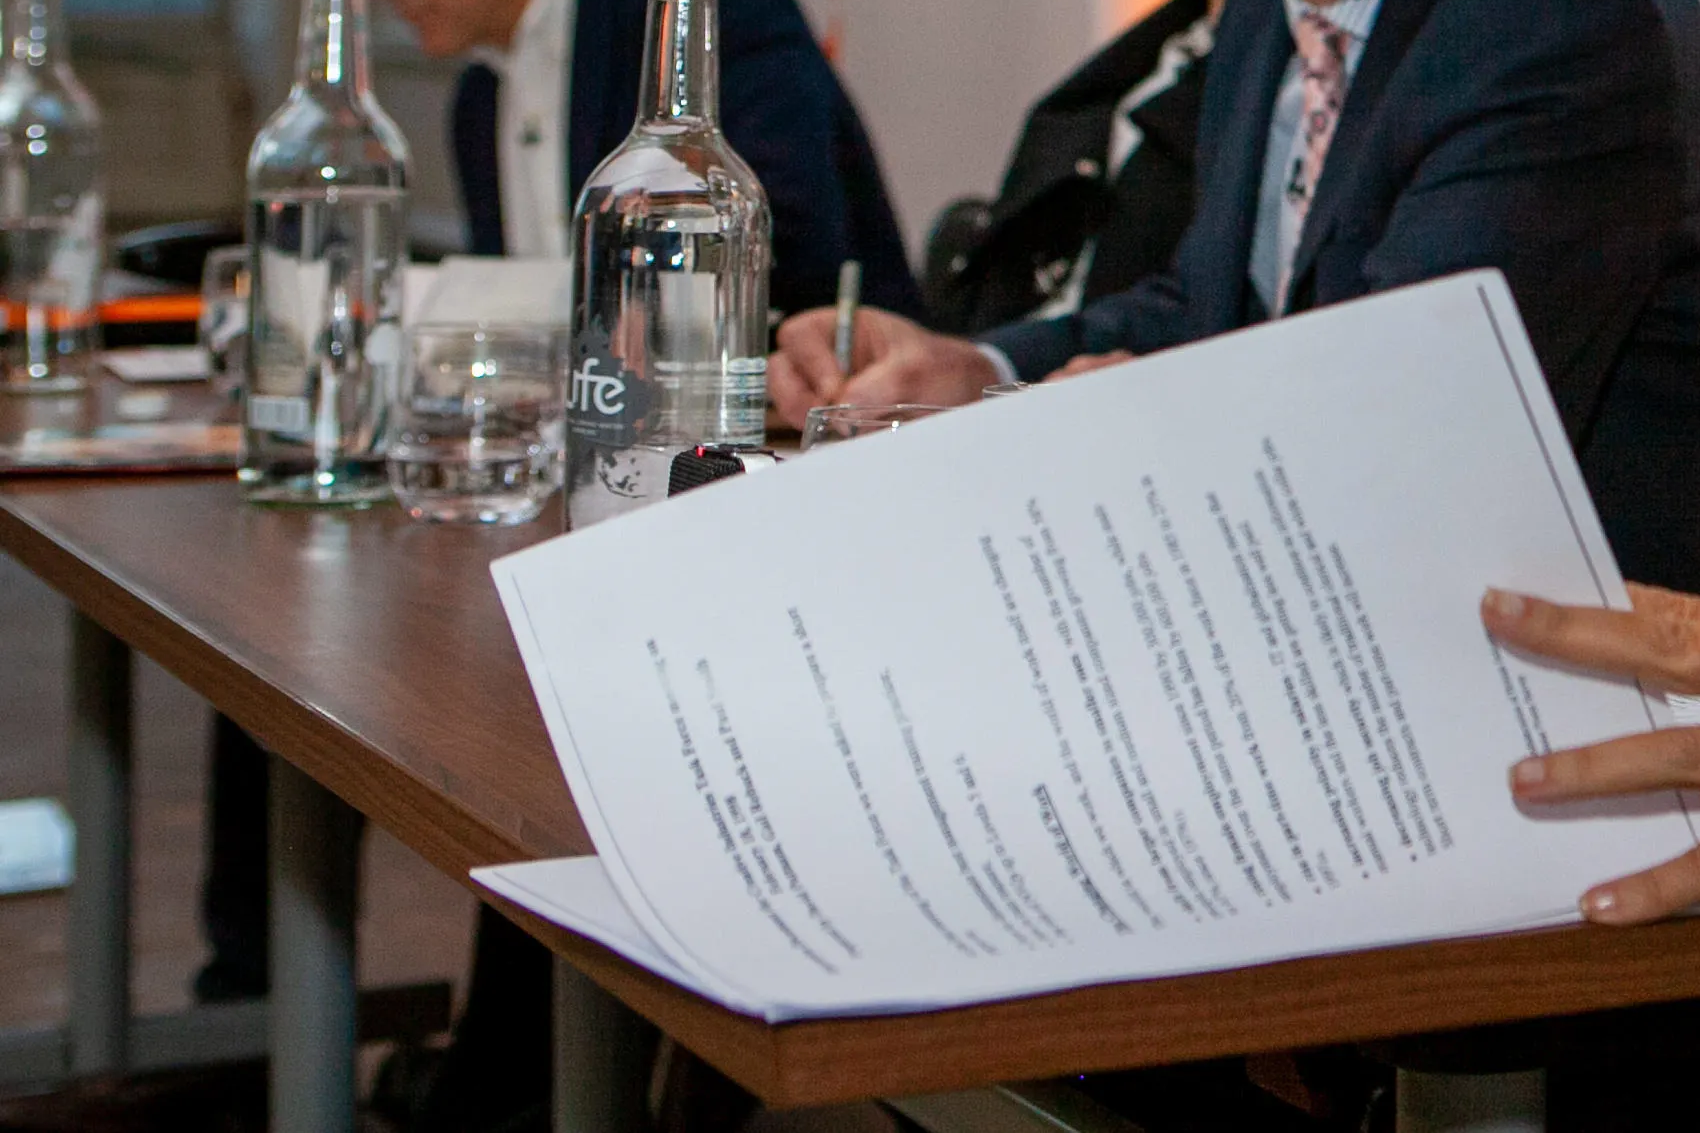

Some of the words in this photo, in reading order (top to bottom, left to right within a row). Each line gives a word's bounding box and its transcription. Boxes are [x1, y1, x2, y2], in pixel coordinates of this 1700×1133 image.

[1035, 525, 1060, 557] from
[1298, 529, 1318, 552] and
[975, 532, 1012, 592] changing
[1048, 555, 1084, 609] growing
[1345, 589, 1364, 613] will
[783, 604, 809, 641] short
[1052, 619, 1076, 650] with
[1068, 604, 1109, 675] companies
[1193, 608, 1217, 642] work
[1259, 624, 1280, 649] and
[1311, 610, 1338, 646] likely
[1353, 612, 1376, 644] work
[1019, 646, 1044, 681] work
[1293, 660, 1319, 702] skilled
[1329, 658, 1353, 695] which
[1094, 674, 1119, 710] sized
[1184, 683, 1205, 709] has
[1277, 675, 1308, 727] salaries
[1354, 669, 1382, 714] number
[1038, 697, 1065, 738] world
[1077, 687, 1108, 739] smaller
[1170, 702, 1195, 737] since
[1233, 709, 1256, 743] from
[1343, 696, 1377, 751] security
[1372, 715, 1390, 736] the
[1386, 699, 1406, 722] and
[668, 715, 697, 758] Force
[1193, 707, 1224, 752] period
[1319, 729, 1338, 751] the
[721, 736, 743, 763] and
[1053, 737, 1073, 759] the
[1244, 742, 1270, 781] work
[1327, 751, 1347, 776] and
[1364, 751, 1386, 774] job
[1380, 736, 1409, 788] reduces
[1396, 723, 1428, 782] contracts
[684, 756, 711, 792] Task
[845, 758, 866, 791] were
[1061, 759, 1084, 786] and
[1128, 763, 1149, 788] and
[1183, 735, 1231, 822] employment
[1214, 752, 1235, 785] same
[1304, 743, 1339, 798] polarity
[1027, 783, 1058, 825] Work
[1104, 753, 1147, 827] companies
[1139, 789, 1164, 824] small
[1224, 787, 1244, 809] the
[1337, 777, 1367, 829] workers
[698, 791, 737, 855] Industries
[1258, 779, 1299, 844] part-time
[1373, 774, 1416, 849] decreasing
[1398, 787, 1439, 857] technology
[1132, 825, 1166, 867] larger
[1325, 798, 1367, 868] increasing
[1430, 815, 1455, 850] Short
[1052, 838, 1084, 881] World
